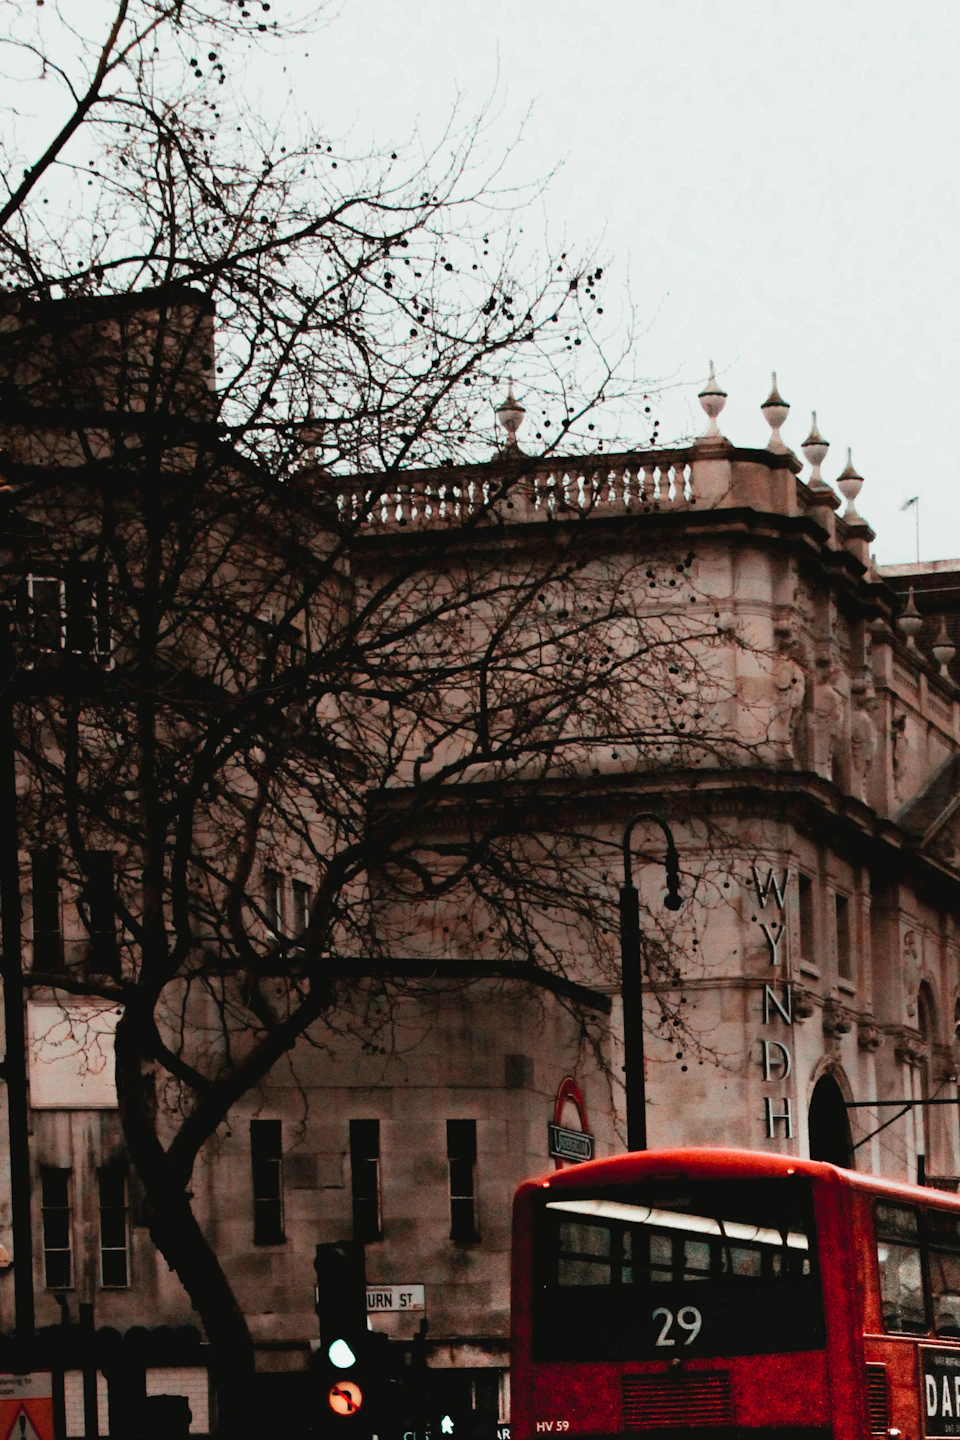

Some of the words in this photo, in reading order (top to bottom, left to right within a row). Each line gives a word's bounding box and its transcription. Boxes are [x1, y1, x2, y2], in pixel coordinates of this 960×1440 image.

[751, 866, 793, 1139] WYNDH
[367, 1293, 392, 1307] URN
[652, 1306, 702, 1346] 29
[536, 1421, 553, 1432] HV
[556, 1421, 569, 1431] 59
